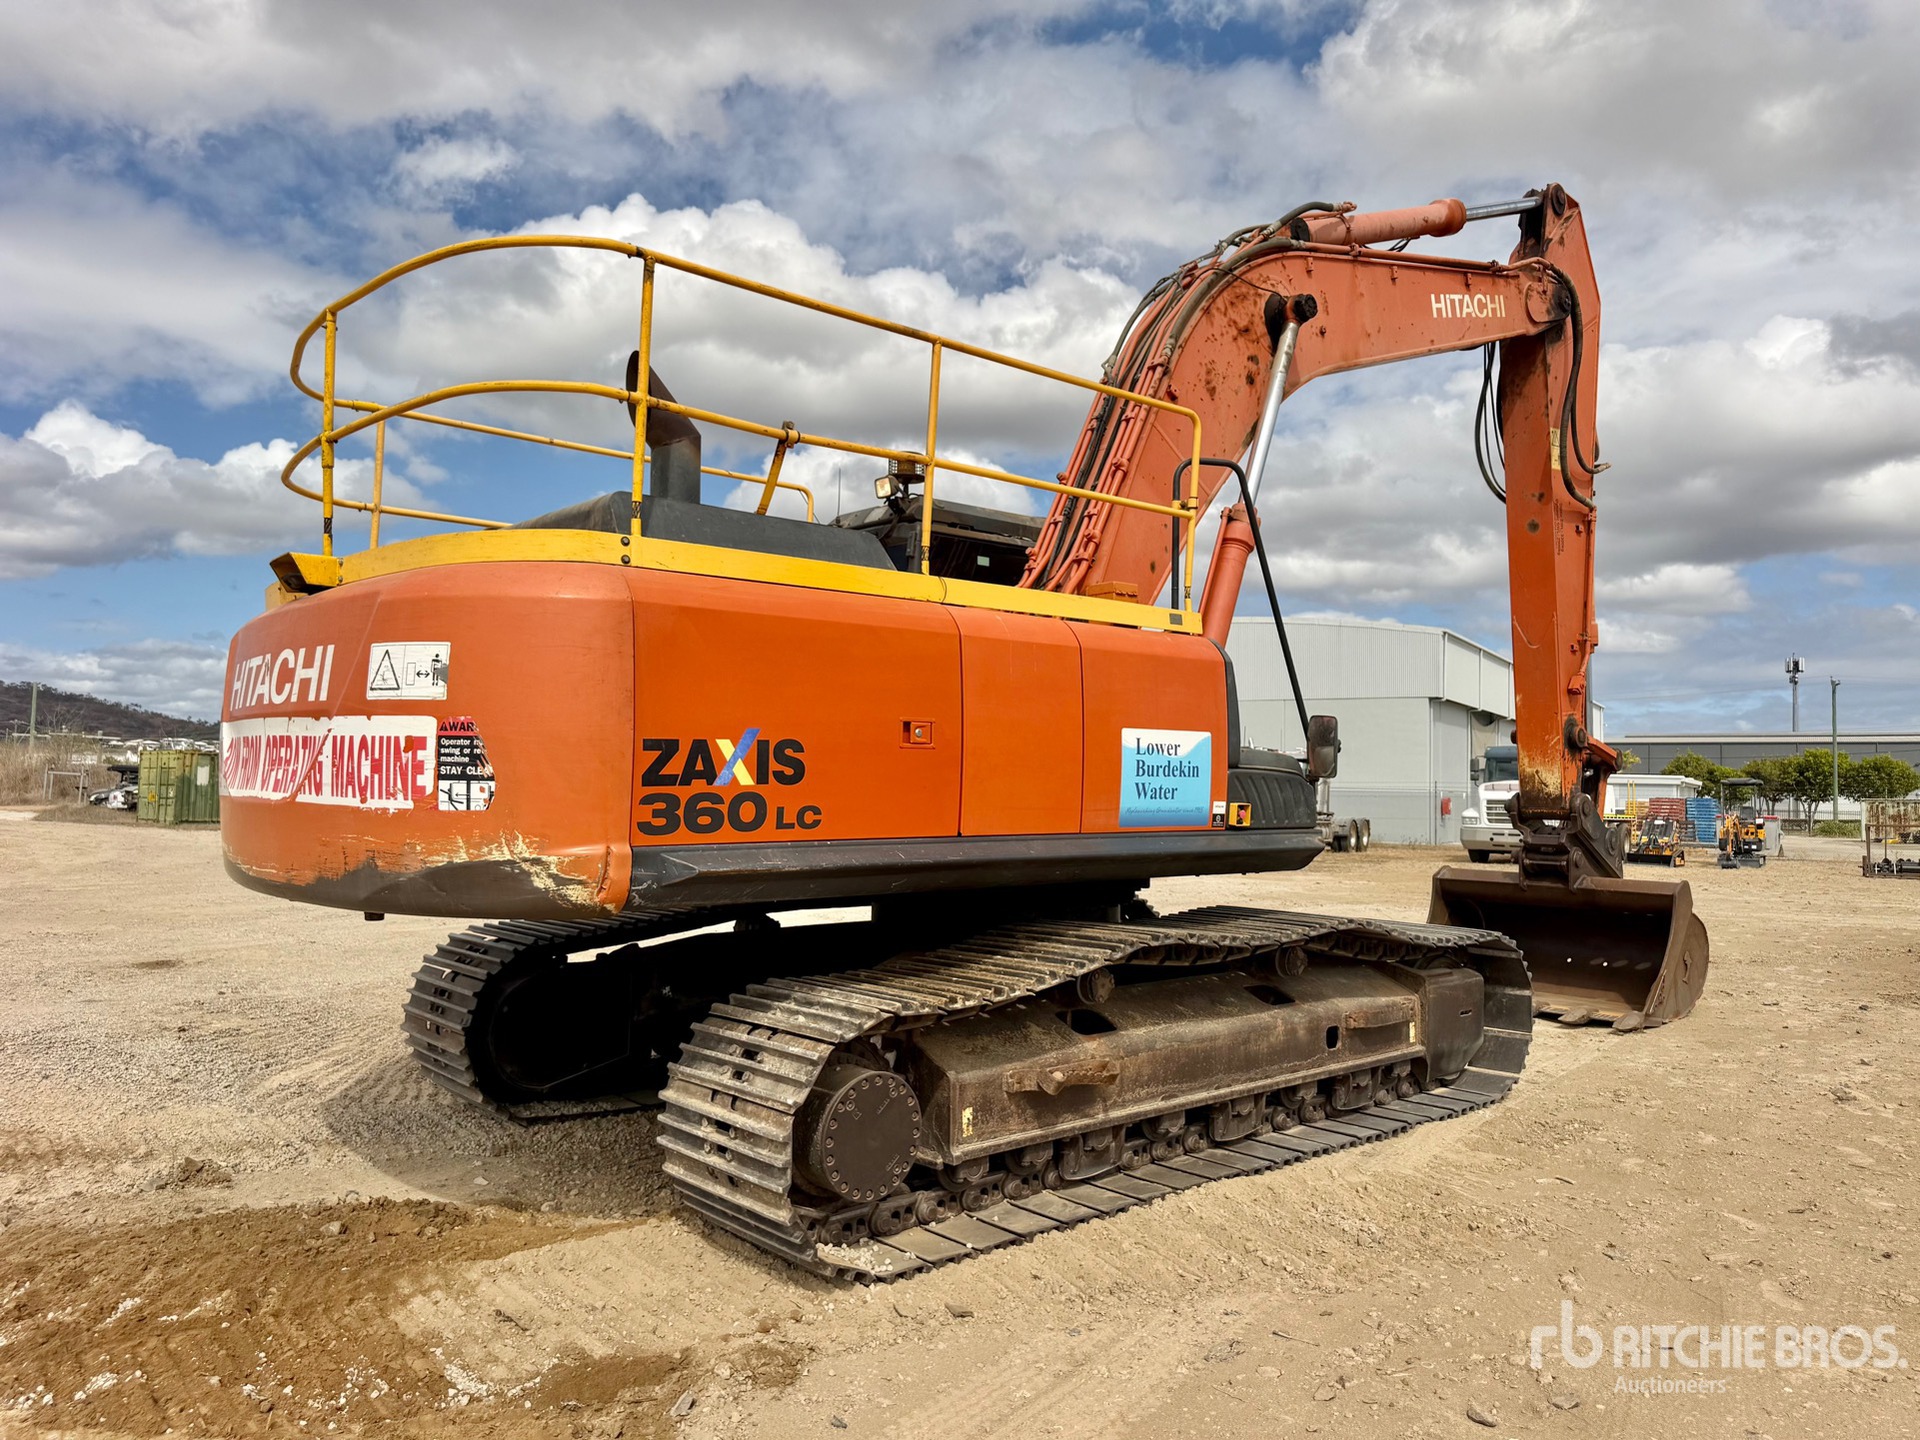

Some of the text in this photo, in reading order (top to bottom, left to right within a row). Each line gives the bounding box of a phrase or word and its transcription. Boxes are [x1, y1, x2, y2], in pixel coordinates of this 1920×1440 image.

[1430, 293, 1506, 318] HITACHI
[230, 644, 335, 712] HITACHI
[440, 738, 471, 747] Operator
[440, 747, 461, 755] swing
[1135, 738, 1181, 756] Lower
[440, 755, 469, 763] machine
[641, 728, 806, 787] ZAXIS
[331, 734, 427, 801] MACHINE
[440, 766, 462, 775] STAY
[1135, 759, 1199, 778] Burdekin
[1135, 782, 1178, 800] Water
[637, 791, 823, 836] 360 LC
